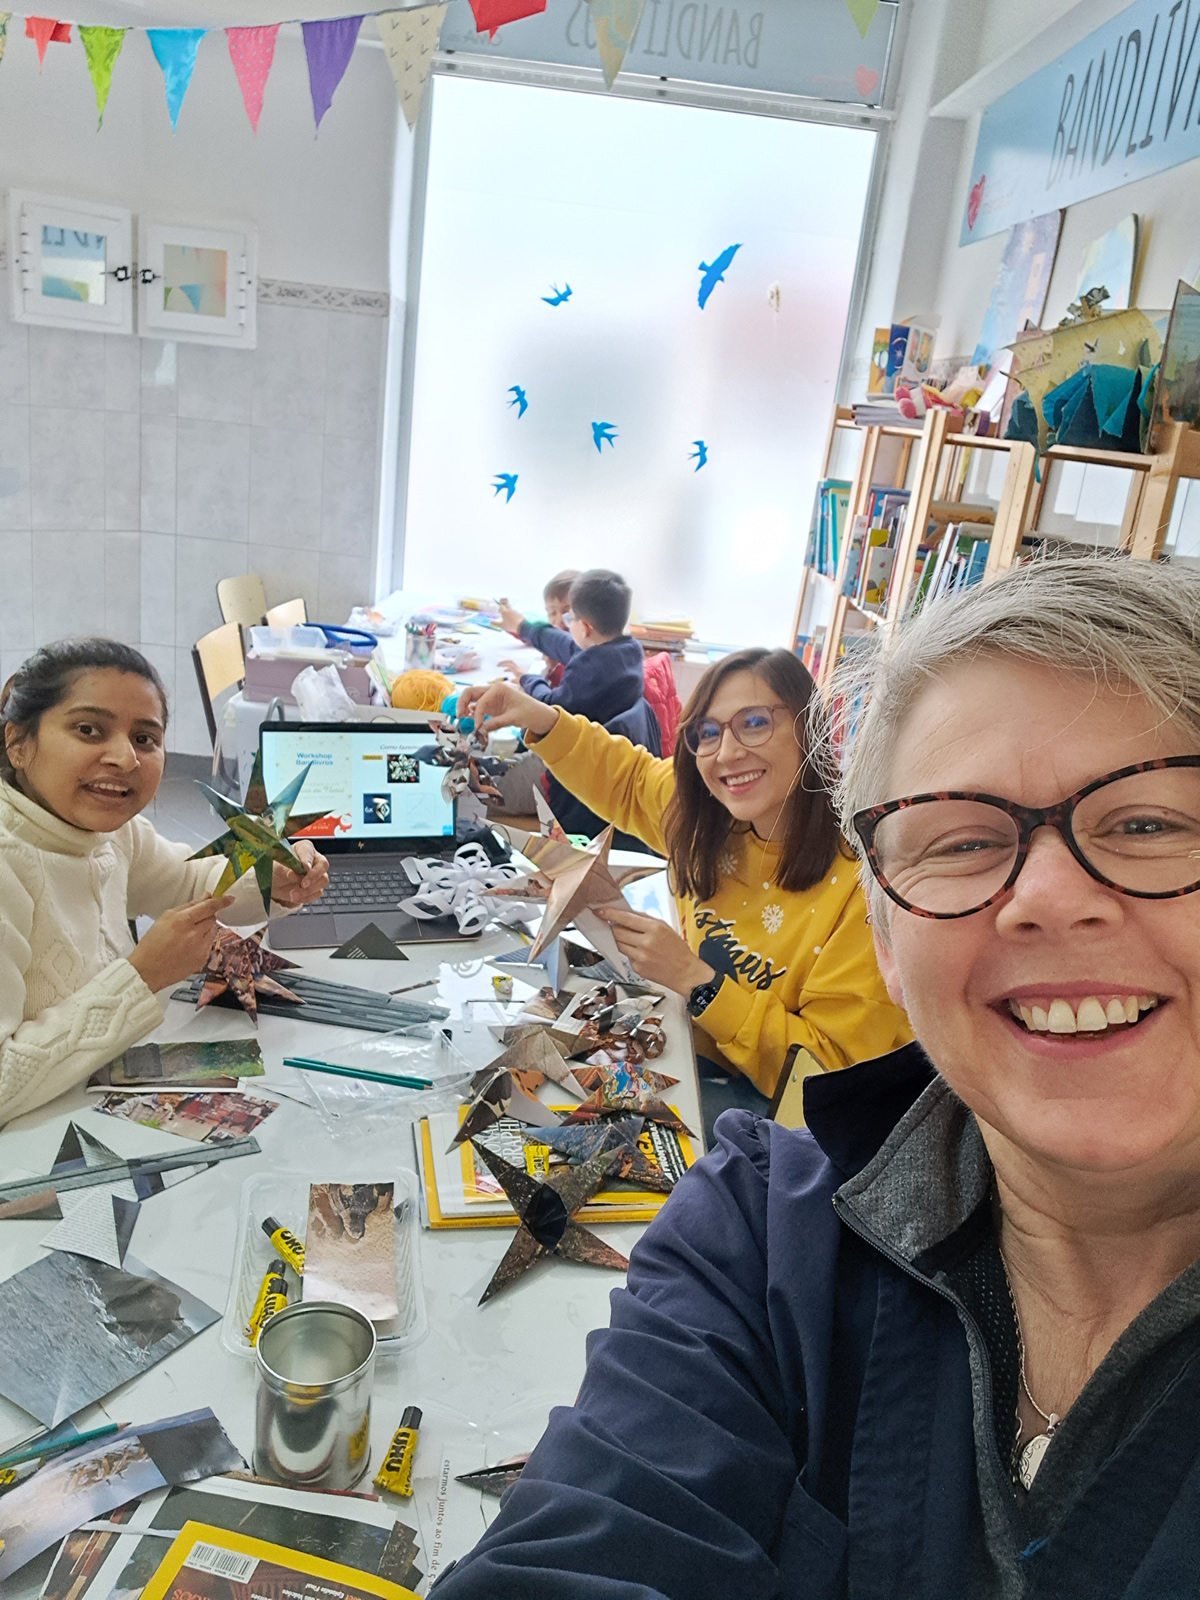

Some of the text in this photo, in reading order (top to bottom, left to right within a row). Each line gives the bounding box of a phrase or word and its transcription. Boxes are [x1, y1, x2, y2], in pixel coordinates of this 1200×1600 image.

[296, 752, 333, 760] Workshop
[694, 908, 787, 990] stmas
[385, 1431, 411, 1473] UHU
[440, 1459, 451, 1496] estarmos
[436, 1496, 448, 1527] juntos
[434, 1528, 442, 1539] ao
[432, 1541, 443, 1557] fim
[430, 1559, 440, 1571] de
